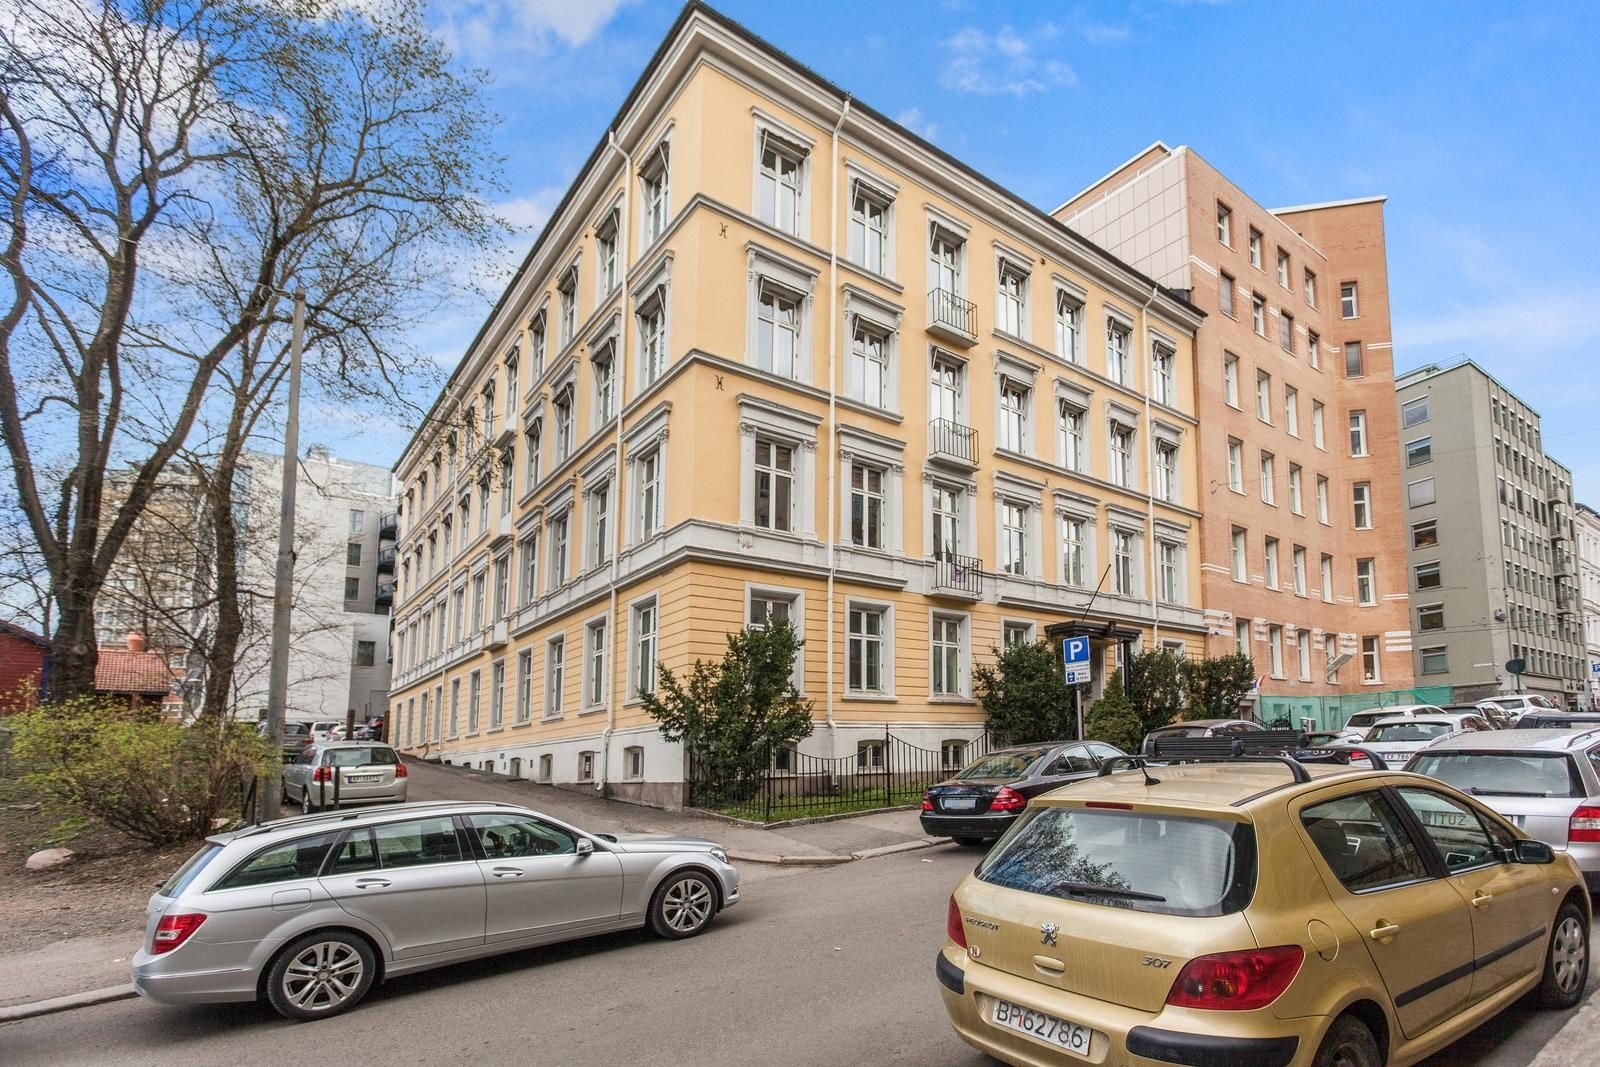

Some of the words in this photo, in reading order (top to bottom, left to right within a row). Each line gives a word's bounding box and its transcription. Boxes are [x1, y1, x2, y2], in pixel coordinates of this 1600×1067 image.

[1069, 641, 1083, 660] P
[966, 916, 999, 930] PEUGEOT
[1142, 955, 1172, 969] 307
